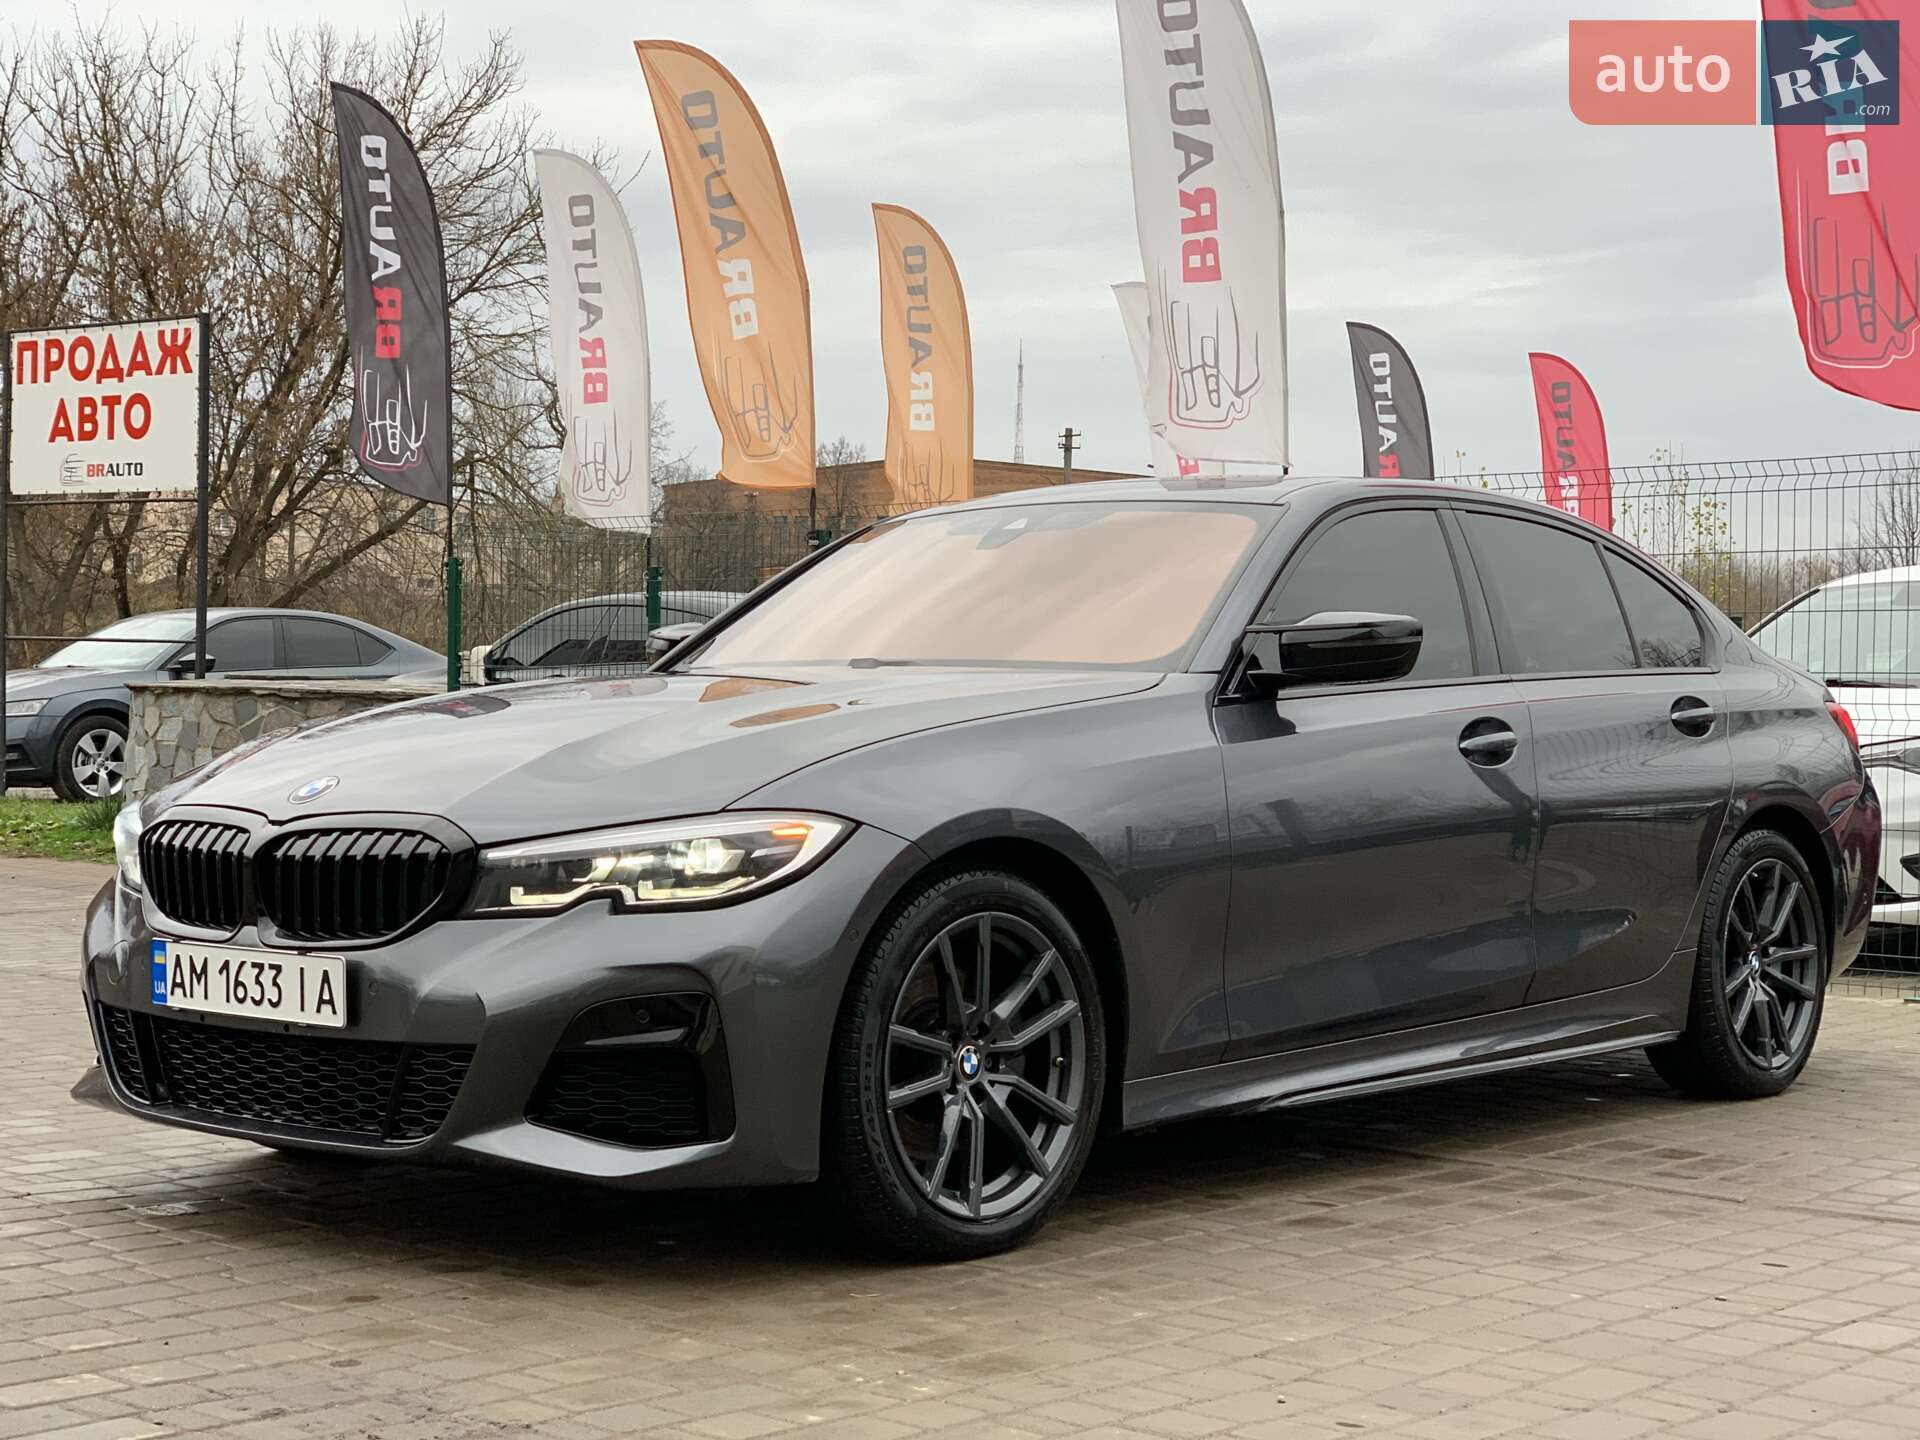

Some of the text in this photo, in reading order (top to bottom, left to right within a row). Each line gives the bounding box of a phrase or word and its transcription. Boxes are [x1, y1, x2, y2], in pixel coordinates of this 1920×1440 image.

[16, 327, 193, 385] ПРОДАЖ
[48, 392, 152, 443] АВТО
[86, 462, 144, 477] BRAUTO
[154, 981, 166, 994] UA
[170, 954, 338, 1015] AM 1633 IA
